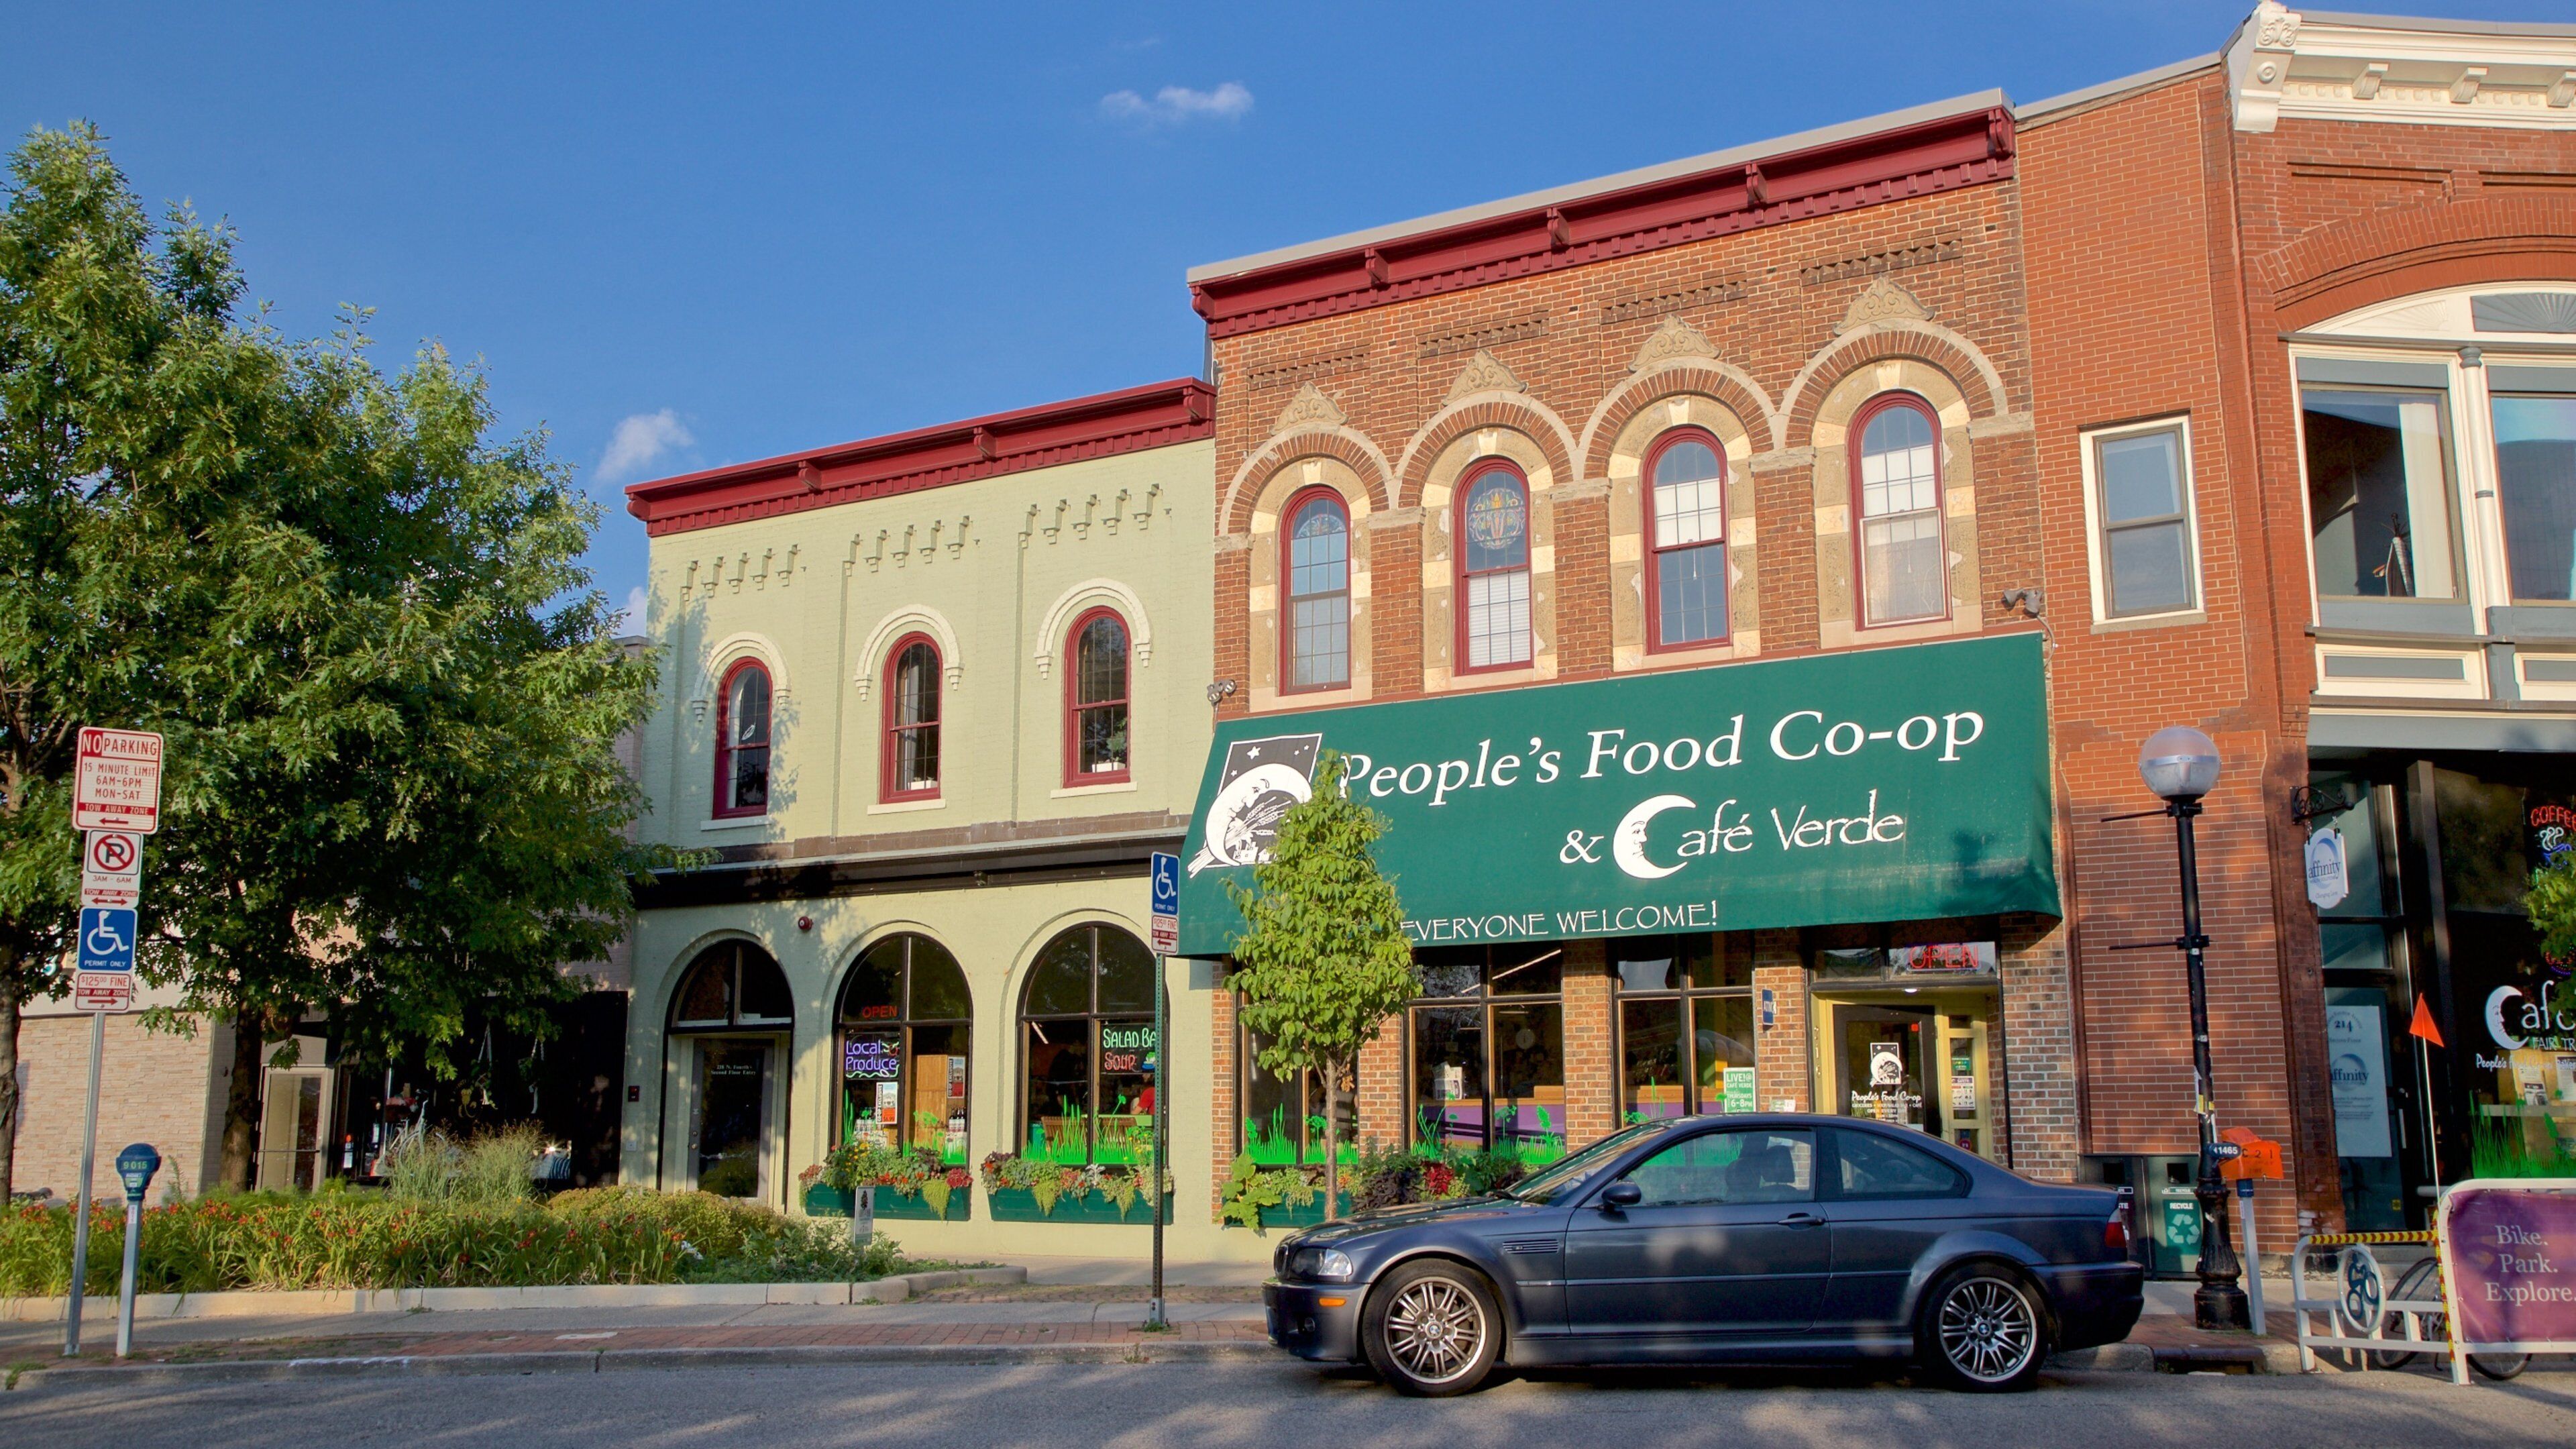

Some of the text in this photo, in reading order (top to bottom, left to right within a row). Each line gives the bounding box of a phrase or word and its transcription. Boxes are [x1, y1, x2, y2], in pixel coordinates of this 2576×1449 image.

[82, 734, 157, 756] NO PARKING
[1338, 710, 1984, 806] People's Food Co-op
[85, 763, 156, 777] 15 MINUTE LIMIT
[96, 775, 142, 788] 6AM-6PM
[95, 788, 141, 800] MON-SAT
[85, 804, 149, 815] TOW AWAY ZONE
[1559, 788, 1904, 879] & Café Verde
[2308, 859, 2341, 879] affinity
[1399, 900, 1717, 943] EVERYONE WELCOME!
[1910, 944, 1978, 969] OPEN
[109, 977, 127, 987] FINE
[863, 1006, 898, 1018] OPEN
[2334, 1020, 2353, 1032] 214
[846, 1038, 881, 1055] Local
[1103, 1027, 1157, 1048] SALAD BA
[2532, 1036, 2557, 1051] FAIR
[846, 1056, 897, 1071] Produce
[1105, 1051, 1136, 1071] SOUP
[2475, 1053, 2507, 1072] People's
[1851, 1090, 1921, 1103] People's Food Co-op
[2495, 1225, 2548, 1246] Bike.
[2498, 1252, 2558, 1273] Park.
